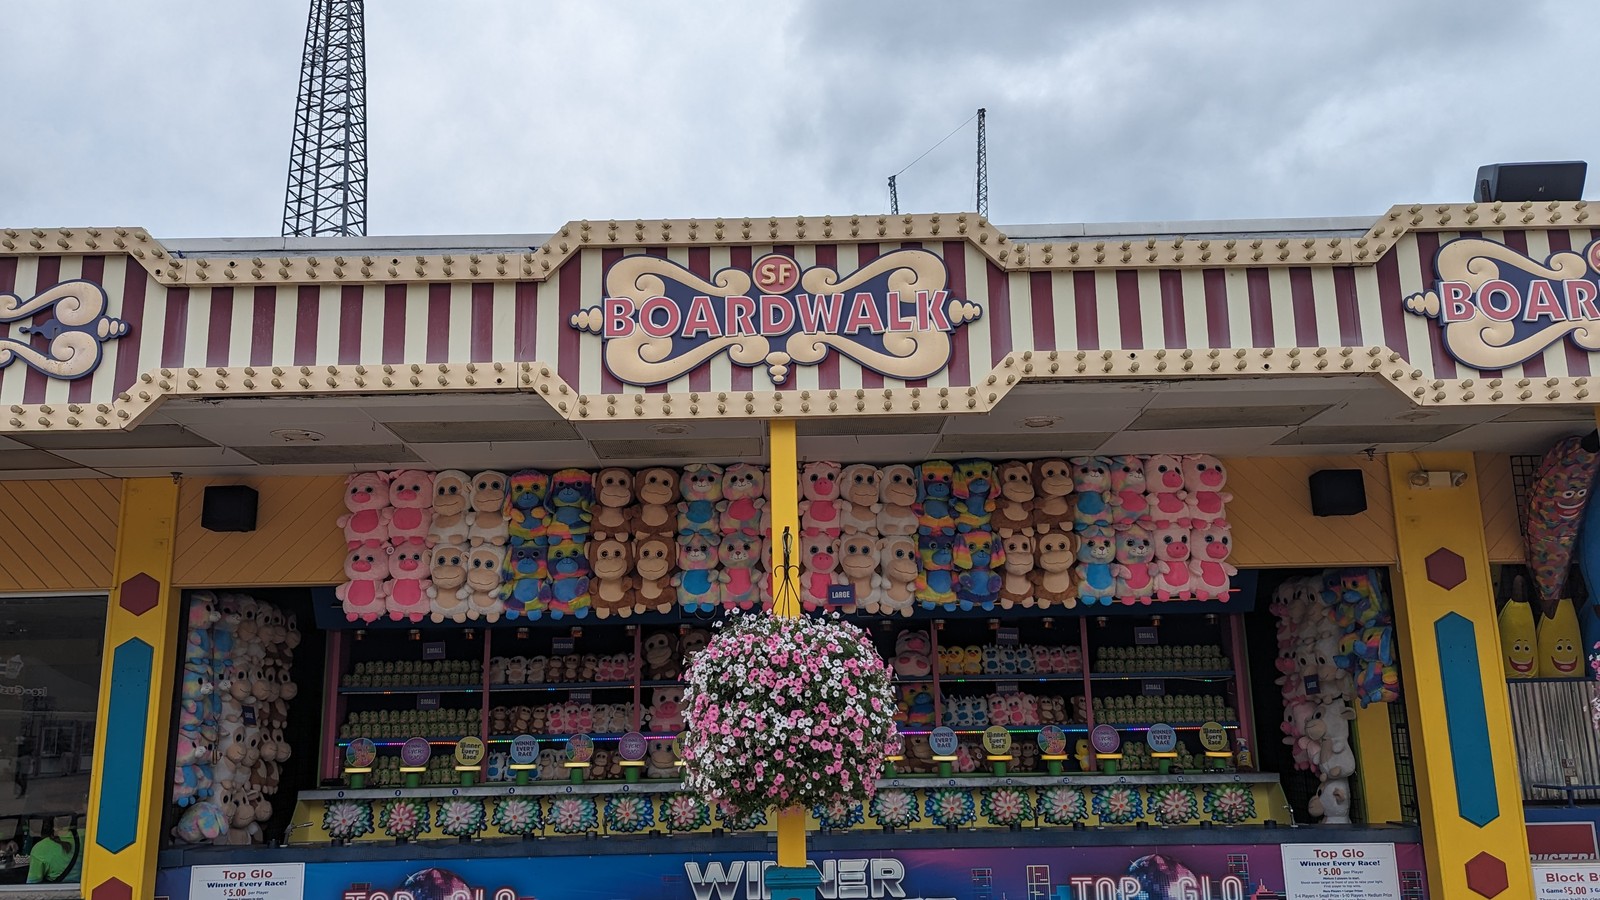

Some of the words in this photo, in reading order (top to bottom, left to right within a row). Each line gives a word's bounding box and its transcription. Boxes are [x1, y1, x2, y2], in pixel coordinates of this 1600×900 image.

[761, 263, 791, 286] SF
[1439, 279, 1600, 323] BOAR
[603, 289, 951, 339] BOARDWALK
[831, 590, 851, 599] LARGE
[1313, 849, 1338, 860] Top
[1342, 848, 1365, 858] Glo
[222, 870, 246, 880] Top
[250, 869, 273, 879] Glo
[1318, 867, 1342, 876] $5.00
[1546, 872, 1585, 882] Block
[1589, 872, 1600, 882] B
[223, 888, 247, 897] $5.00
[1563, 886, 1587, 895] $5.00
